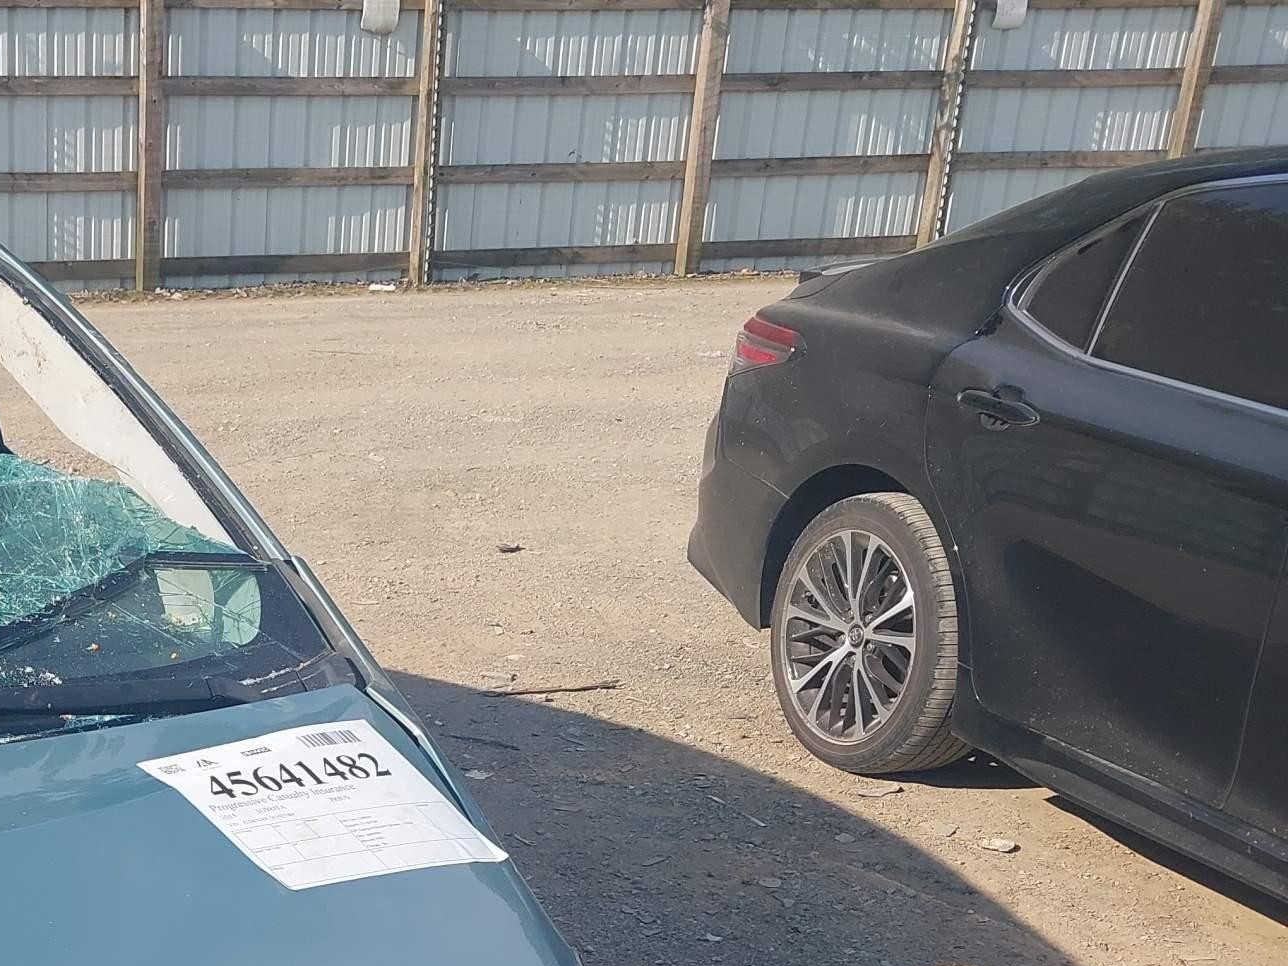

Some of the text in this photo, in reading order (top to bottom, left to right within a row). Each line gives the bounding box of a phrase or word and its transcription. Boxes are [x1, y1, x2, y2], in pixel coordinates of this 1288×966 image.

[210, 752, 393, 798] 45641482
[208, 783, 356, 813] Progressive Casualty Insurance
